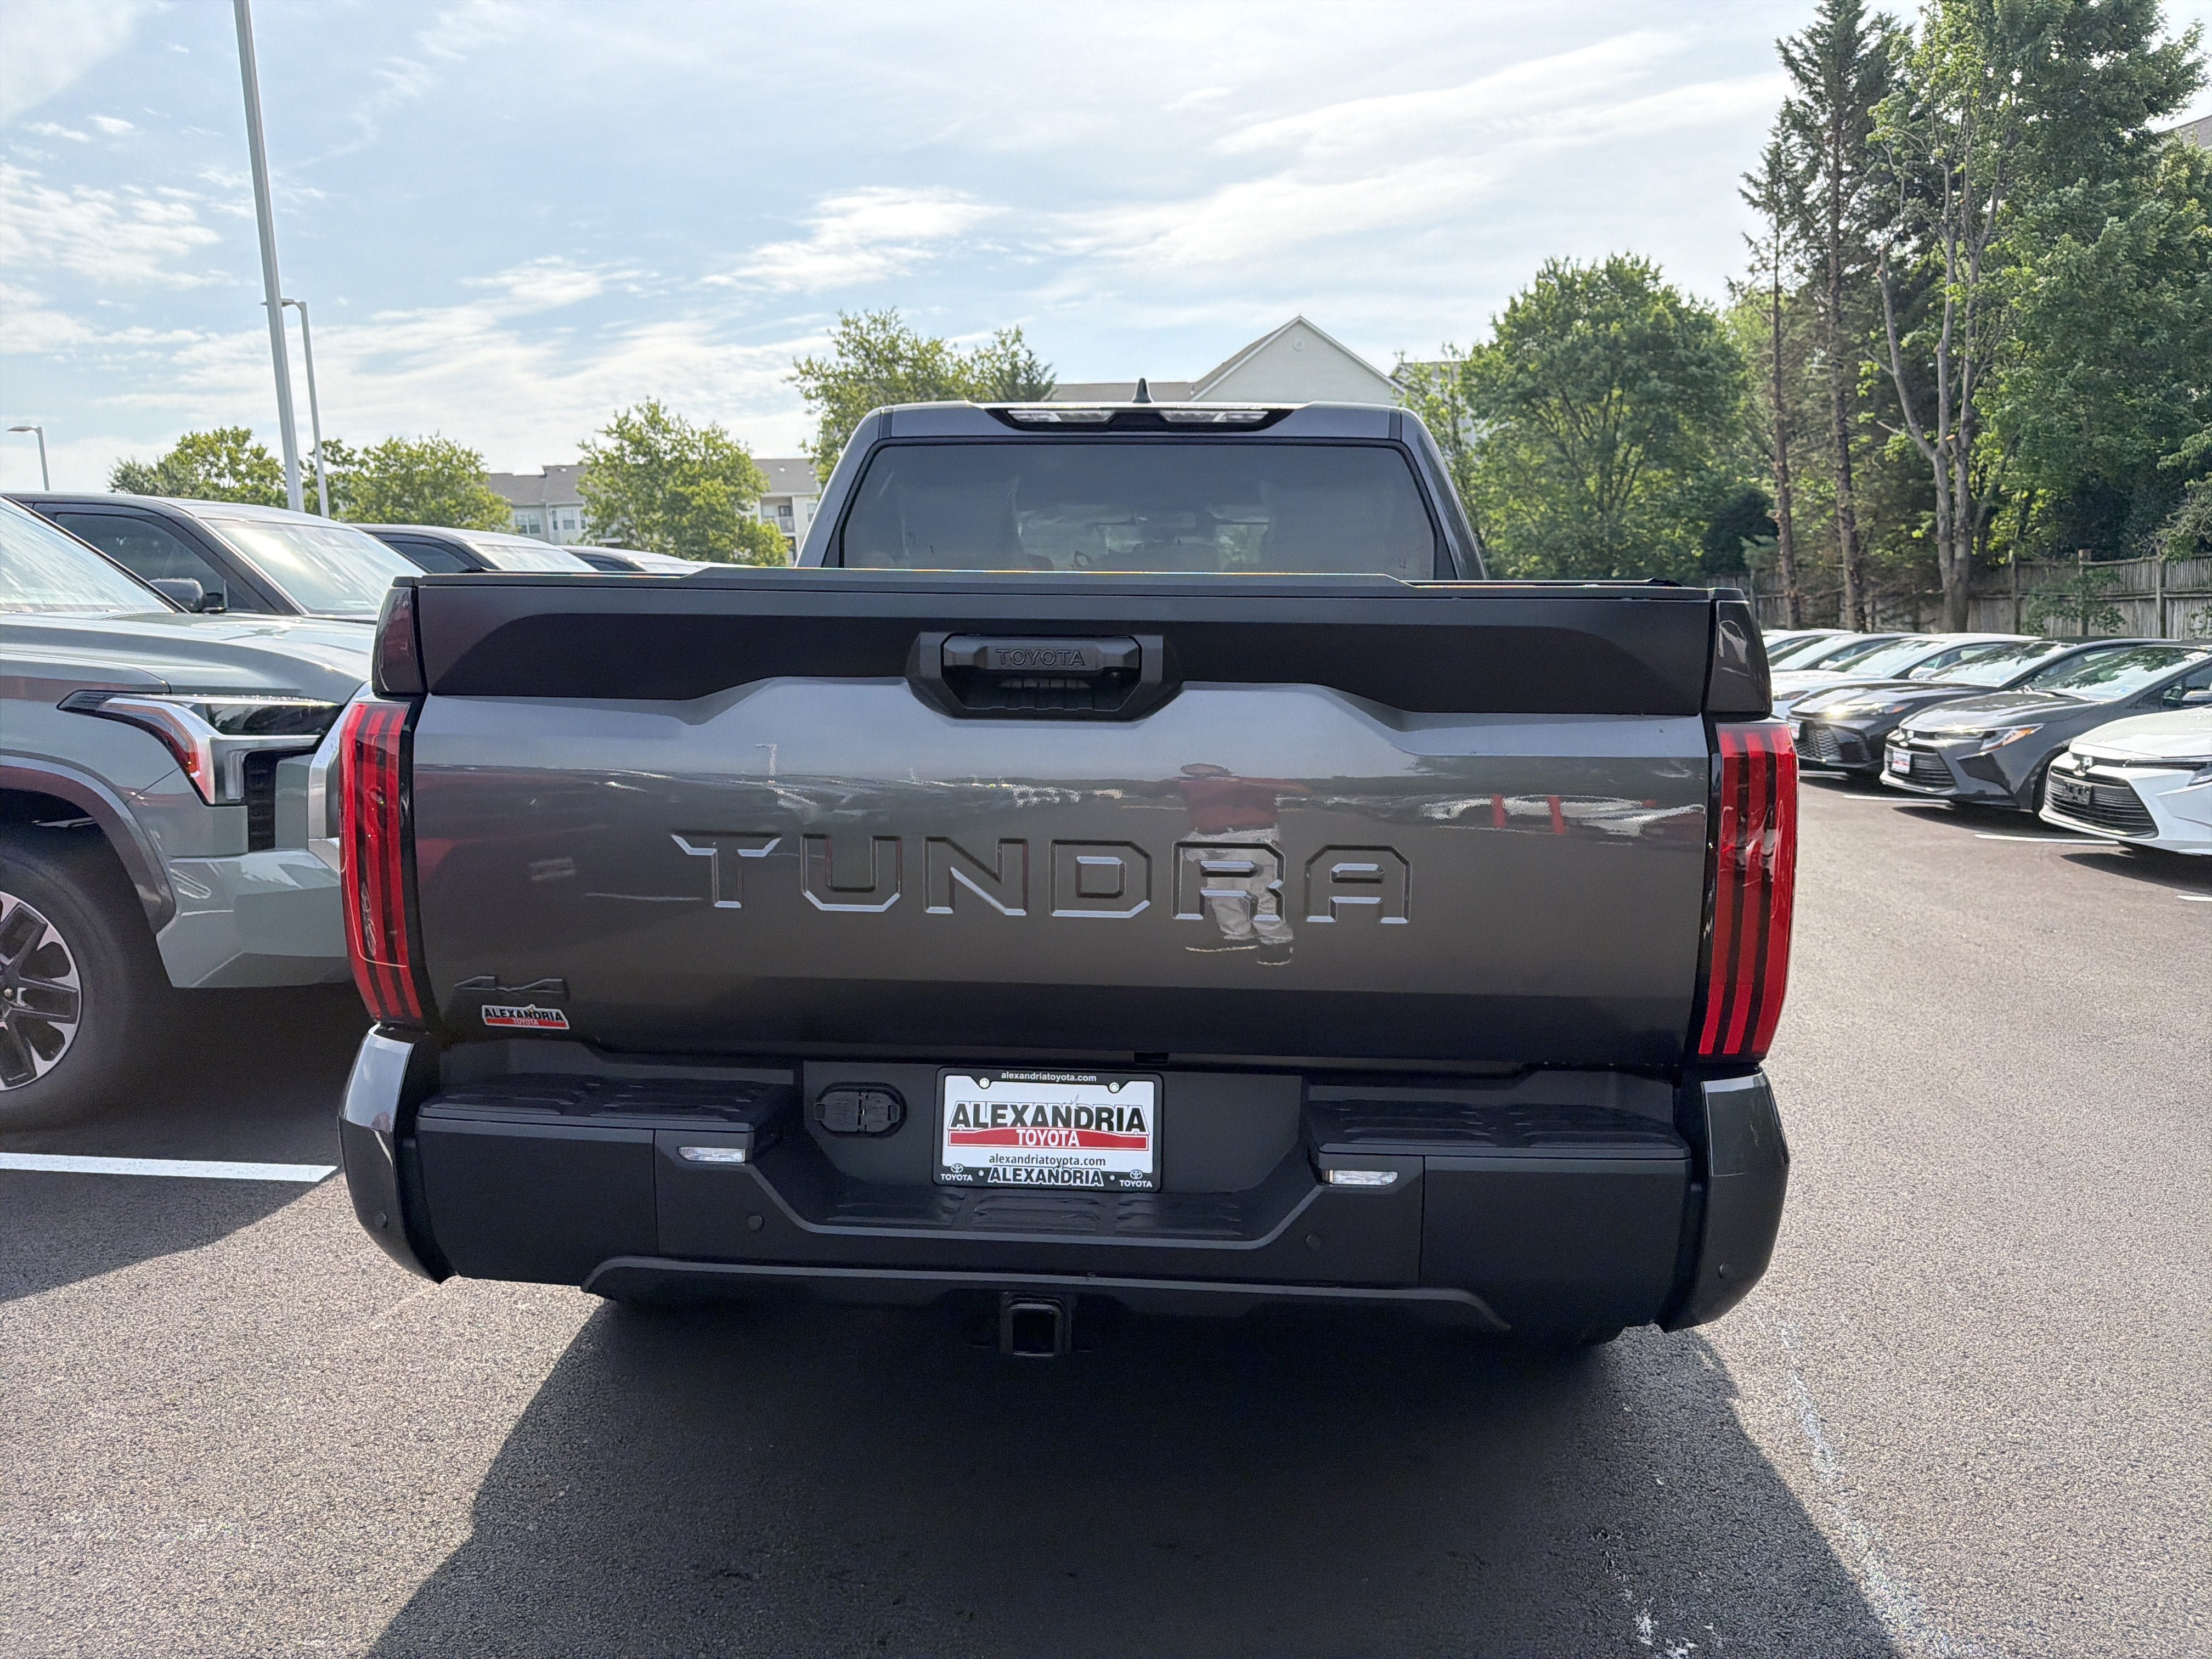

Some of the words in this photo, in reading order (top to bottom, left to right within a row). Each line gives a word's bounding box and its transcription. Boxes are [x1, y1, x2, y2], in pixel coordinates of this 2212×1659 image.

[996, 648, 1085, 666] TOYOTA
[670, 830, 1412, 924] TUNDRA
[485, 1008, 564, 1021] ALEXANDRIA
[1001, 1071, 1097, 1082] alexandriatoyota.com
[950, 1103, 1147, 1132] ALEXANDRIA
[1016, 1129, 1080, 1147] TOYOTA
[989, 1154, 1106, 1167] alexandriatoyota.com
[940, 1173, 973, 1182] TOYOTA
[989, 1167, 1102, 1185] ALEXANDRIA
[1119, 1179, 1153, 1188] TOYOTA
